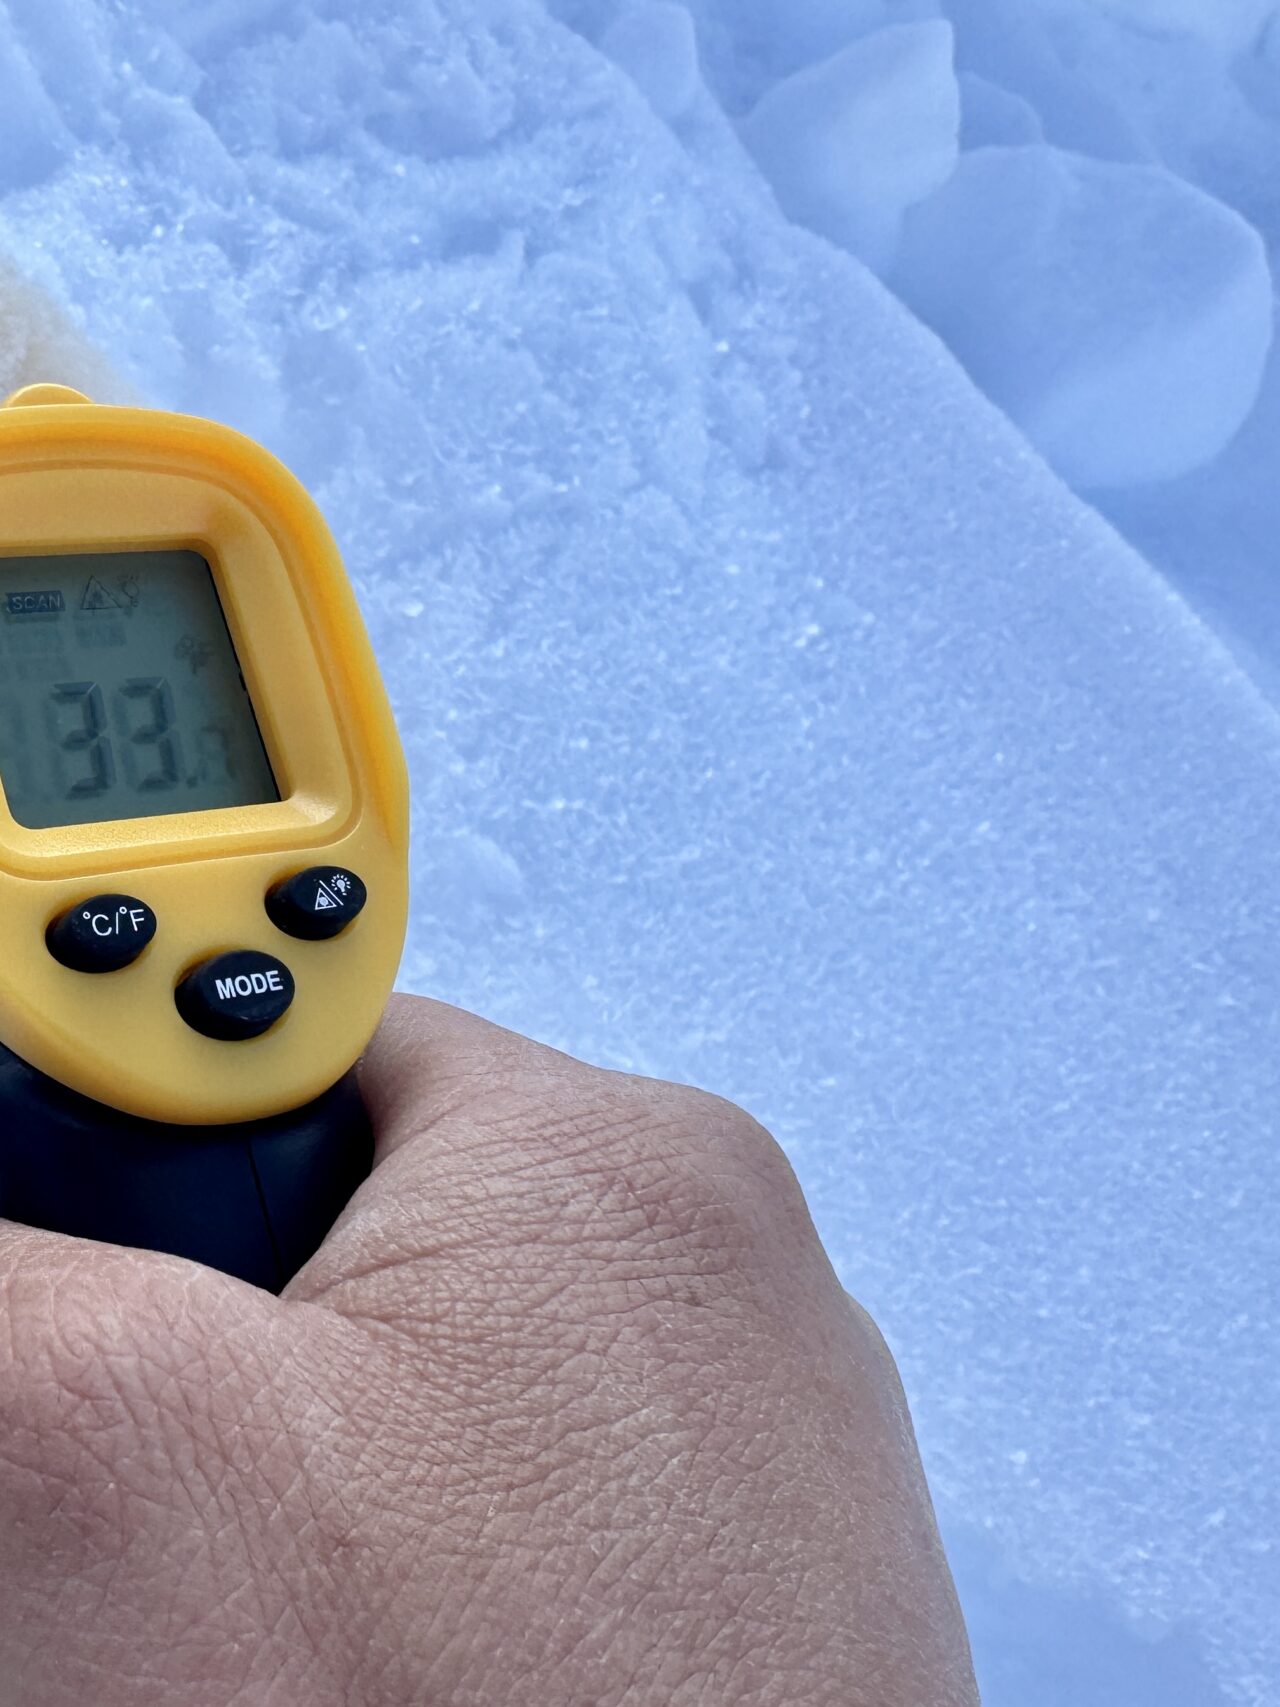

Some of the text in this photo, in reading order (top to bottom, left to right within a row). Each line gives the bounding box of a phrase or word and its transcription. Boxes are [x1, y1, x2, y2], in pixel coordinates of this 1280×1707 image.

[10, 592, 62, 612] SCAN
[82, 905, 145, 937] °C/°F
[215, 969, 284, 1000] MODE
